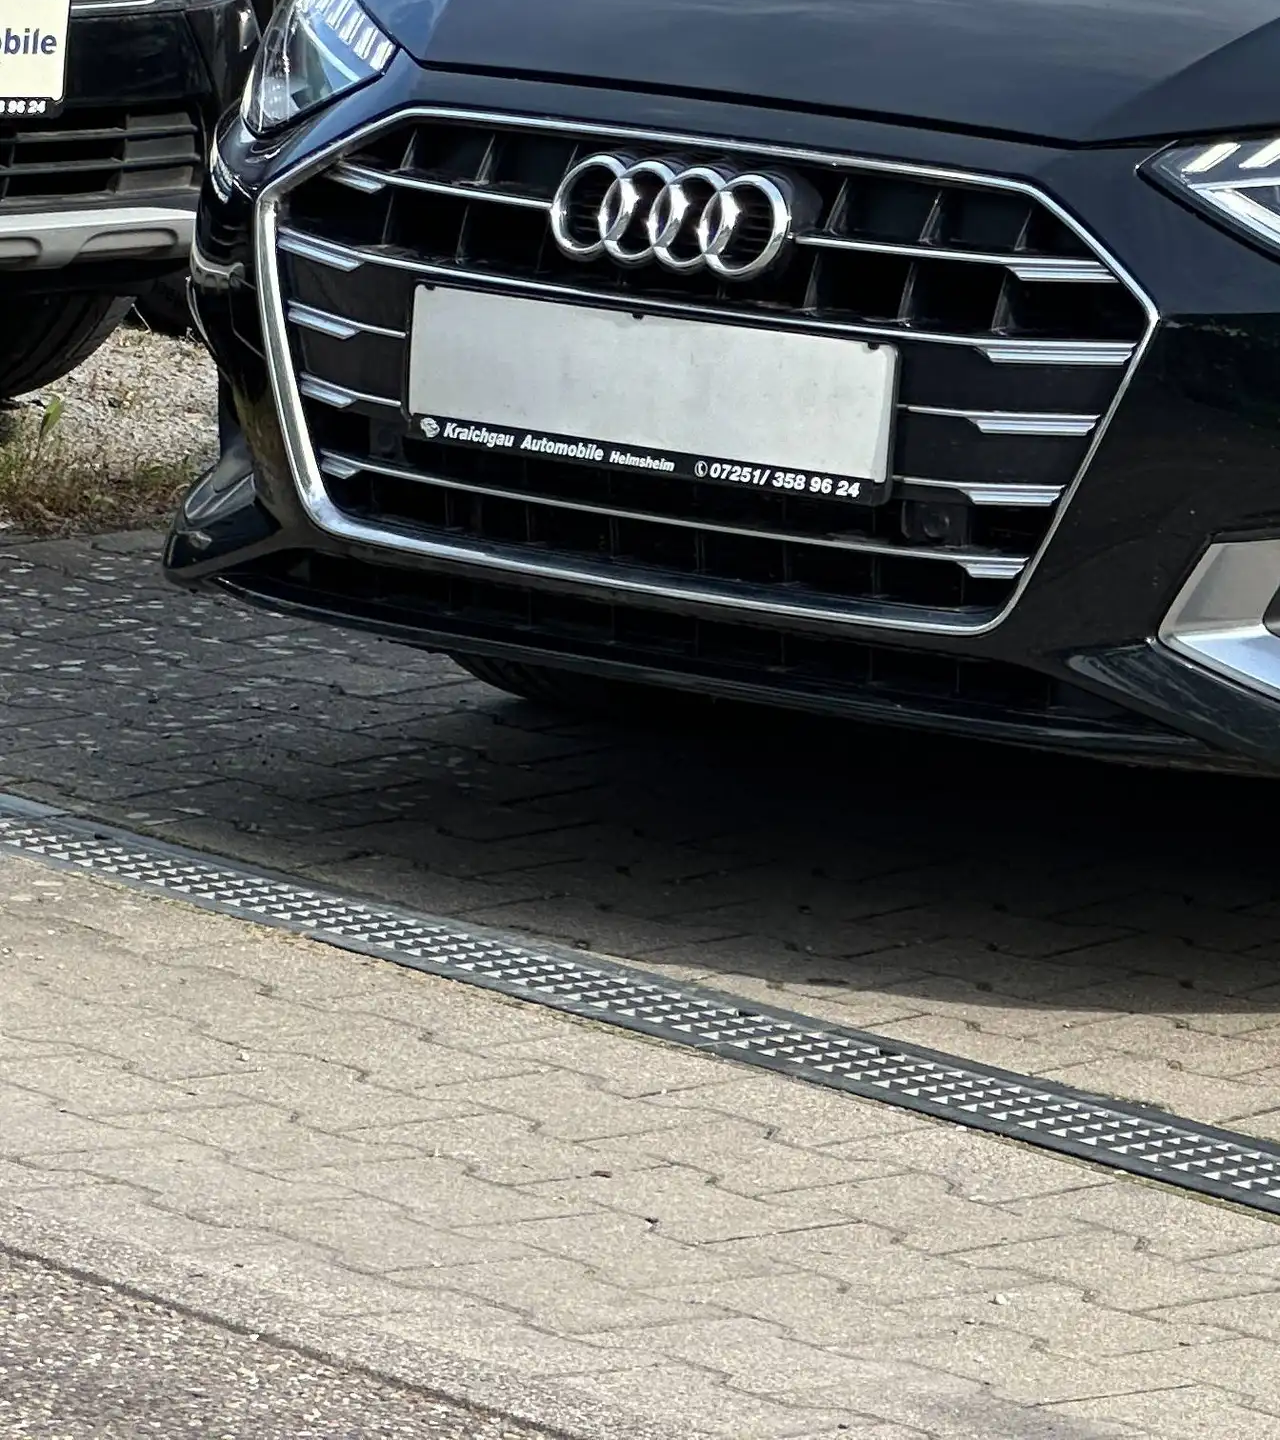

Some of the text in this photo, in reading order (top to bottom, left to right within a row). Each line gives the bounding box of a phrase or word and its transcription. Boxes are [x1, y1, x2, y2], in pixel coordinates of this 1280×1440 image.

[0, 27, 57, 55] bile
[443, 421, 861, 498] Kraichgau Automobile Helmsheim 07251/ 358 96 24
